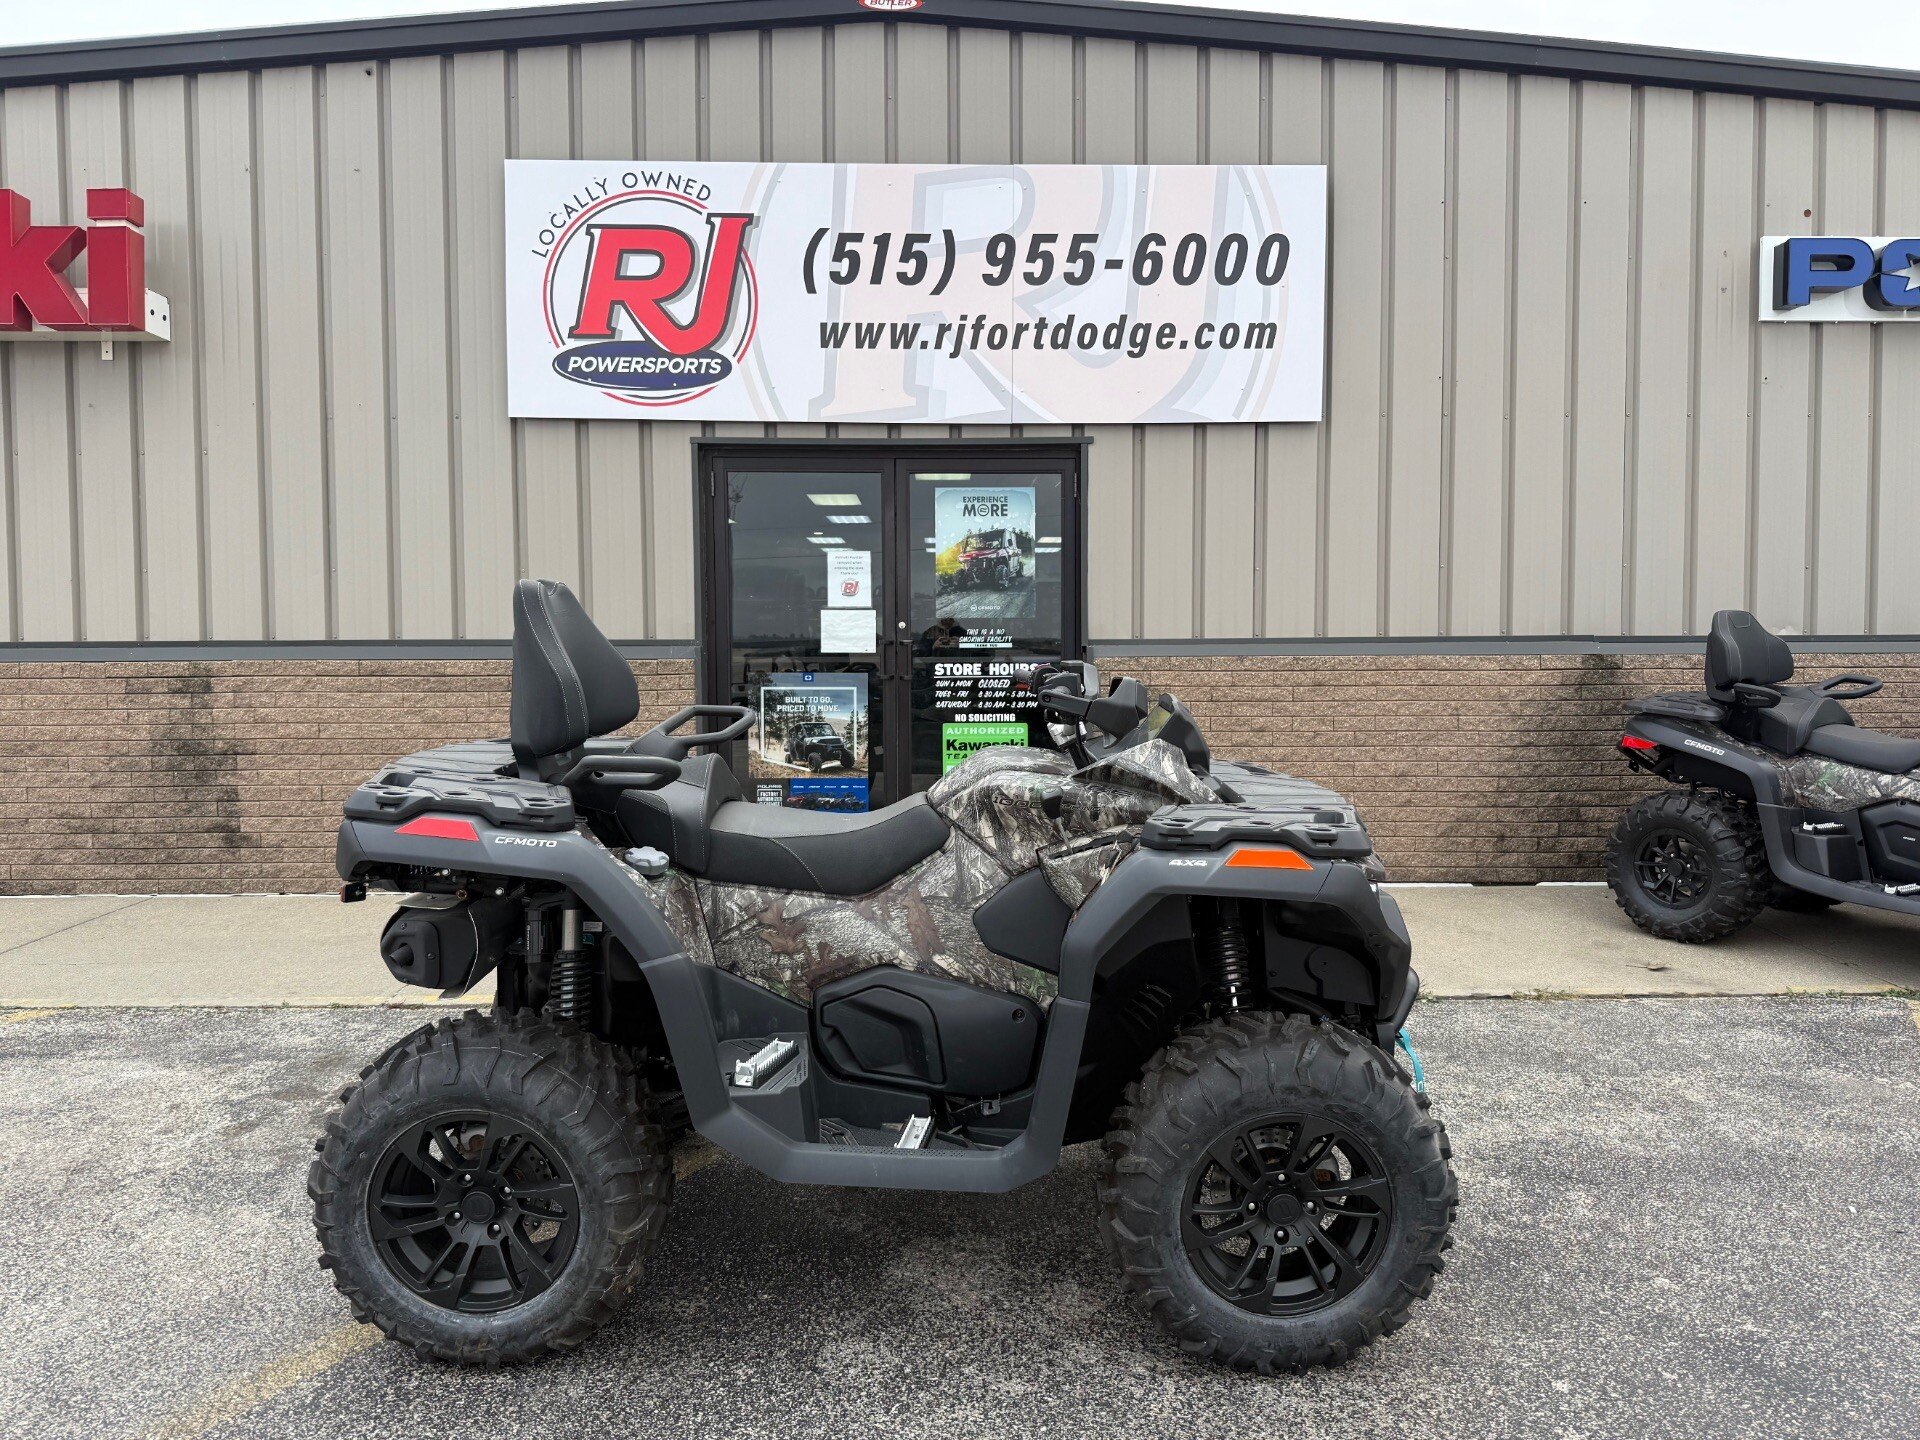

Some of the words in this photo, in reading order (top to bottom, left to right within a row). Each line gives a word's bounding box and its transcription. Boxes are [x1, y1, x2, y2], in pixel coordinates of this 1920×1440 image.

[532, 178, 607, 258] LOCALLY
[622, 171, 711, 202] OWNED
[803, 227, 957, 296] (515)
[982, 232, 1291, 287] 955-6000
[568, 213, 755, 357] RJ
[819, 314, 1278, 358] www.rjfortdodge.com
[567, 356, 722, 374] POWERSPORTS
[934, 663, 982, 676] STORE
[978, 679, 1011, 688] CLOSED
[935, 690, 952, 698] TUES
[954, 713, 967, 722] NO
[968, 713, 1016, 722] SOLICITING
[946, 727, 1024, 735] AUTHORIZED
[1684, 739, 1725, 756] CFMOTO
[494, 836, 558, 848] CFMOTO
